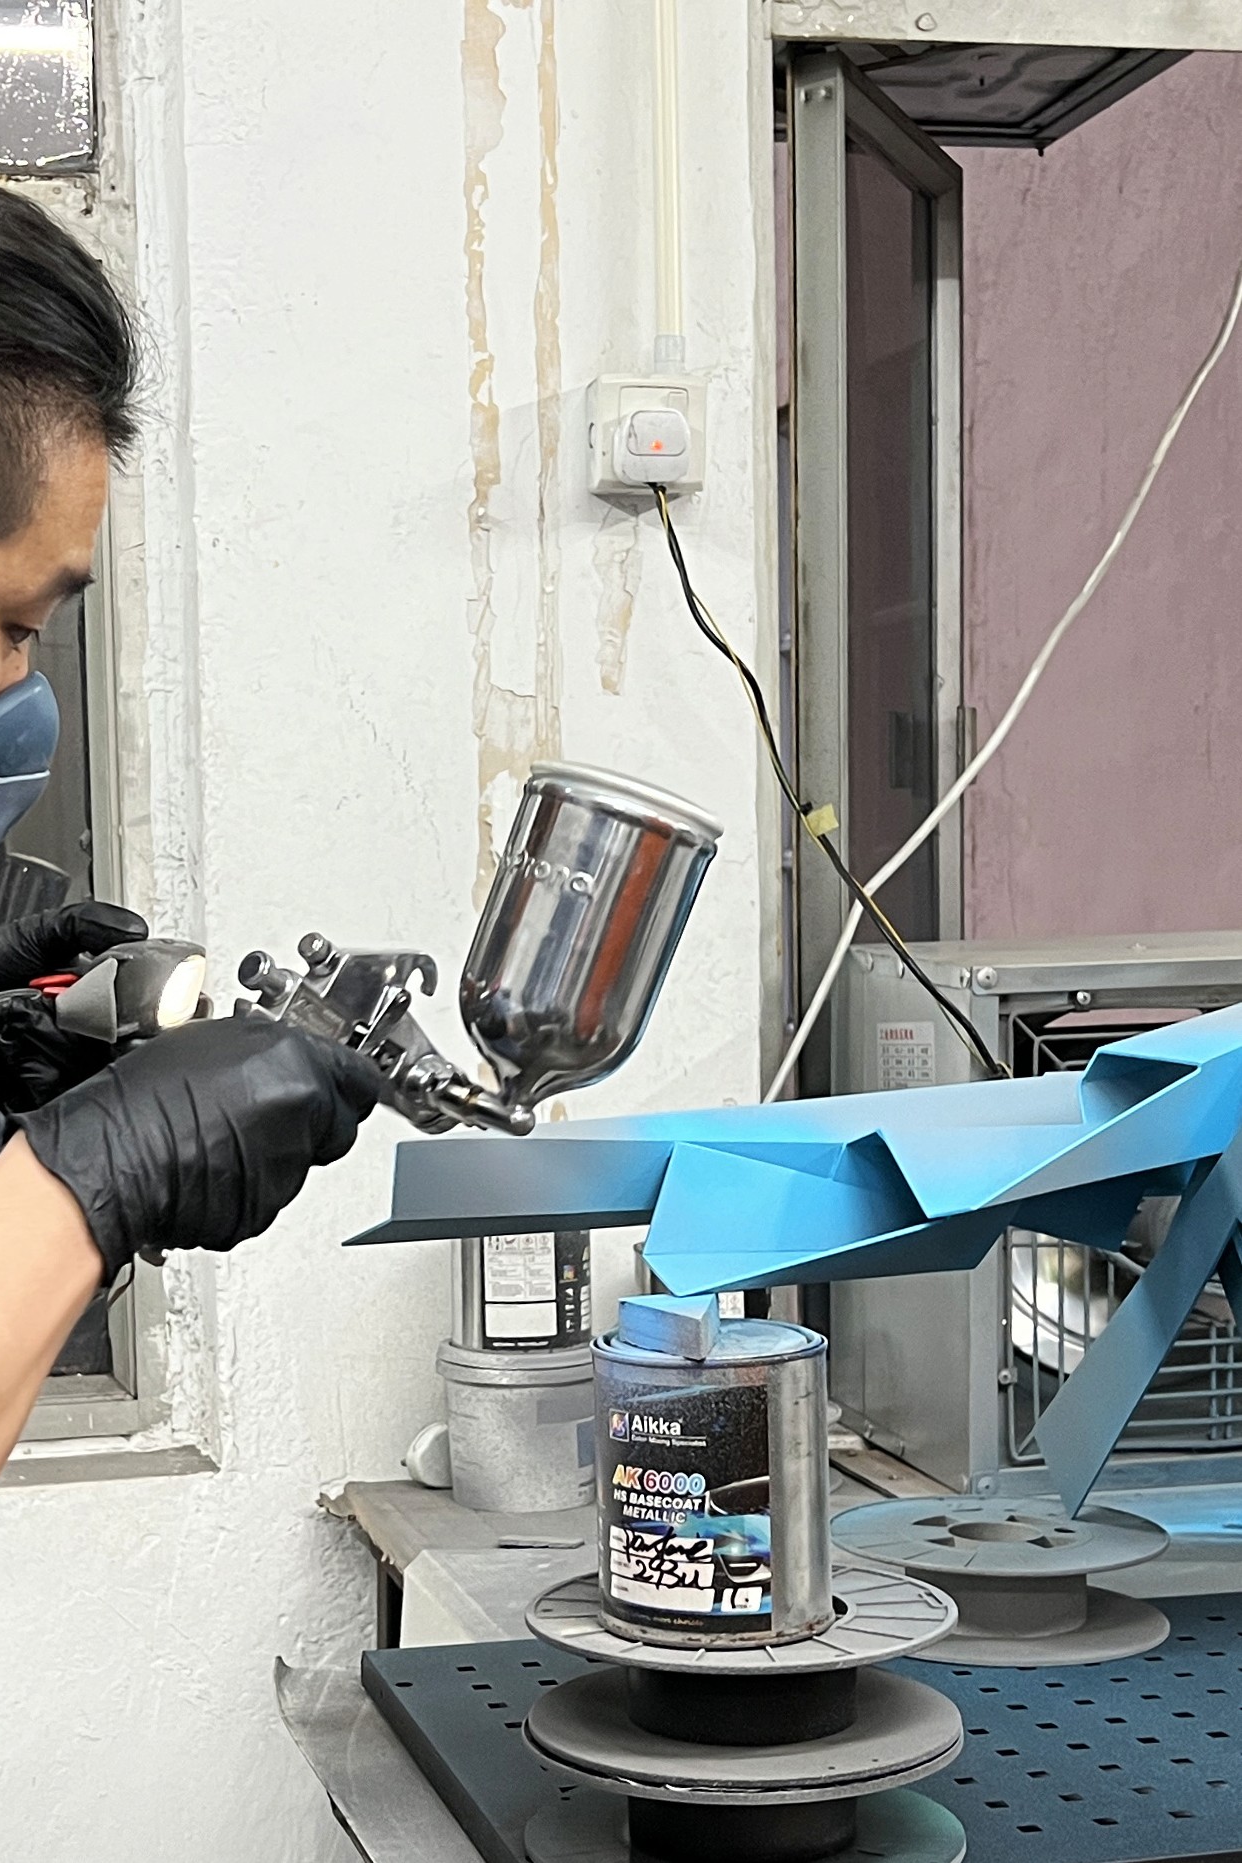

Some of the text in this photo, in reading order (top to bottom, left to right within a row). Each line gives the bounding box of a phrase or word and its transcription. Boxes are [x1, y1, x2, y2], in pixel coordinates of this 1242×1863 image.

[631, 1415, 682, 1436] Aikka
[612, 1464, 706, 1496] AK 6000
[613, 1488, 702, 1511] HS BASECOAT
[622, 1505, 687, 1524] METALLIC
